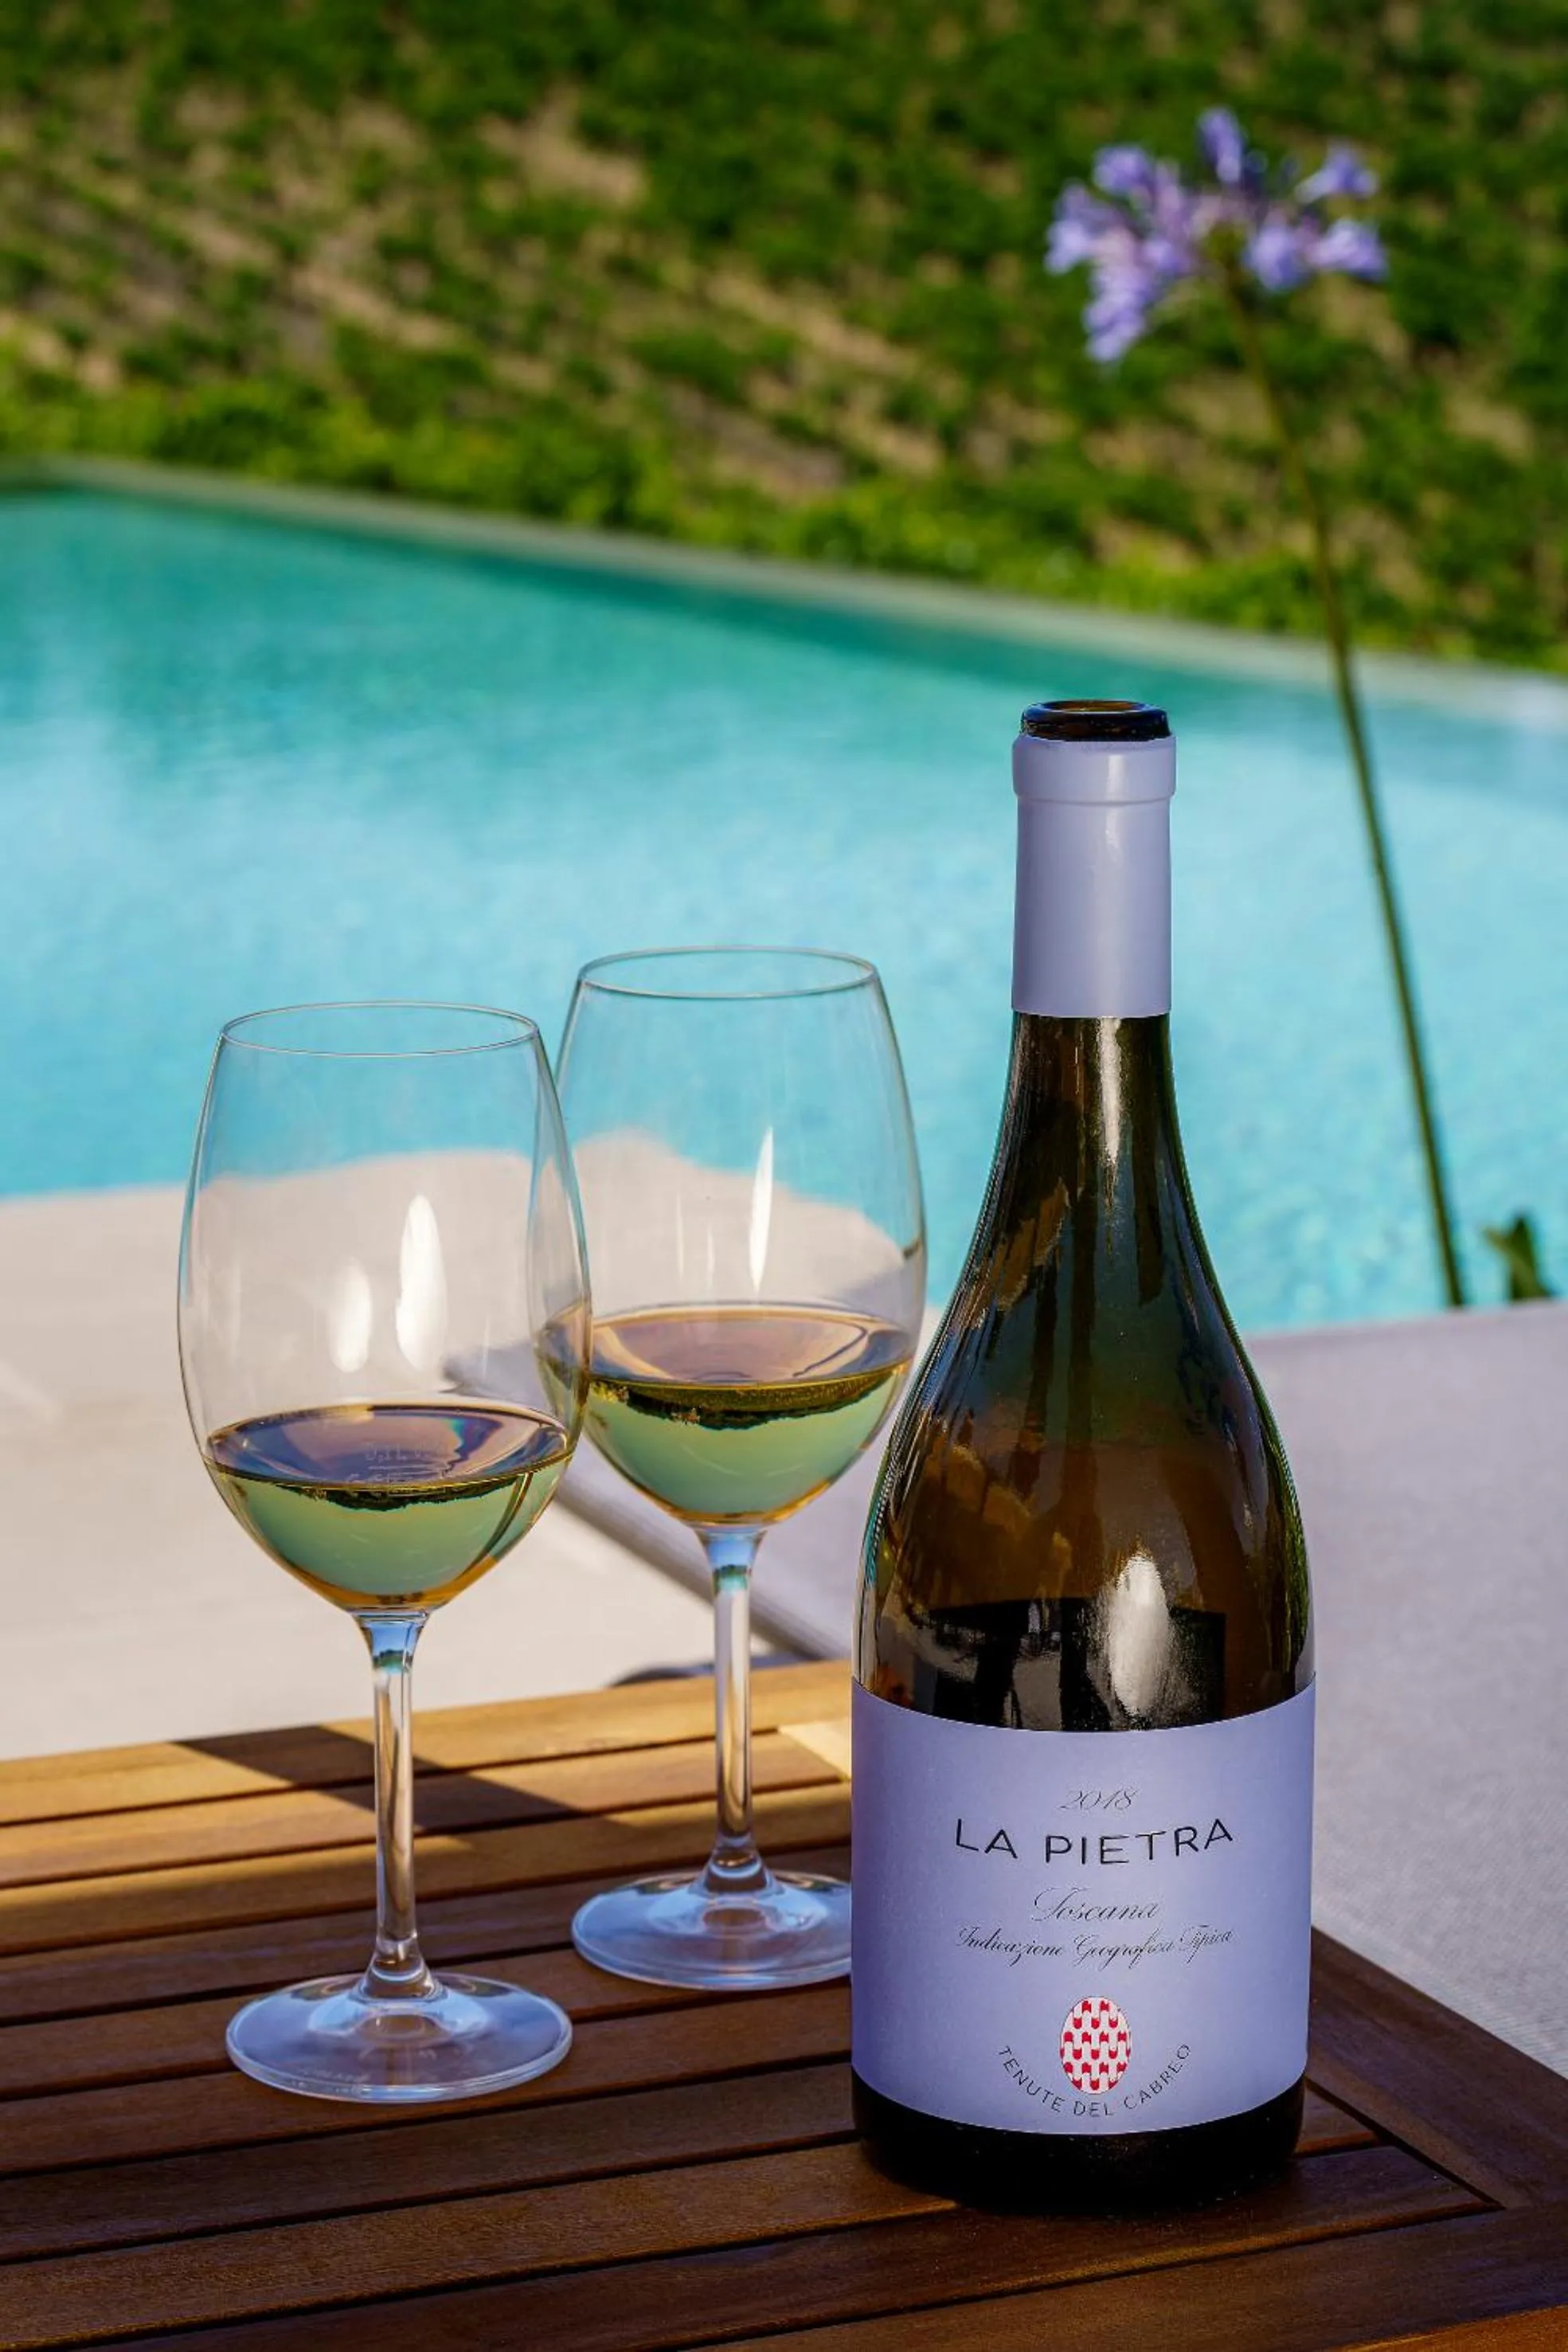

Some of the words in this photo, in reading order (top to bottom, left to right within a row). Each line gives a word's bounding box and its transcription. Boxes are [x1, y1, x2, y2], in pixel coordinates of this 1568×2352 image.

[1054, 1787, 1139, 1811] 2018
[955, 1818, 1019, 1860] LA
[1045, 1818, 1234, 1865] PIETRA
[1031, 1887, 1159, 1921] Toscana
[956, 1926, 1063, 1967] Indicazione
[1073, 1925, 1174, 1971] Geografica
[998, 2045, 1066, 2113] TENUTE
[1073, 2100, 1115, 2118] DEL
[1123, 2043, 1191, 2111] CABREO
